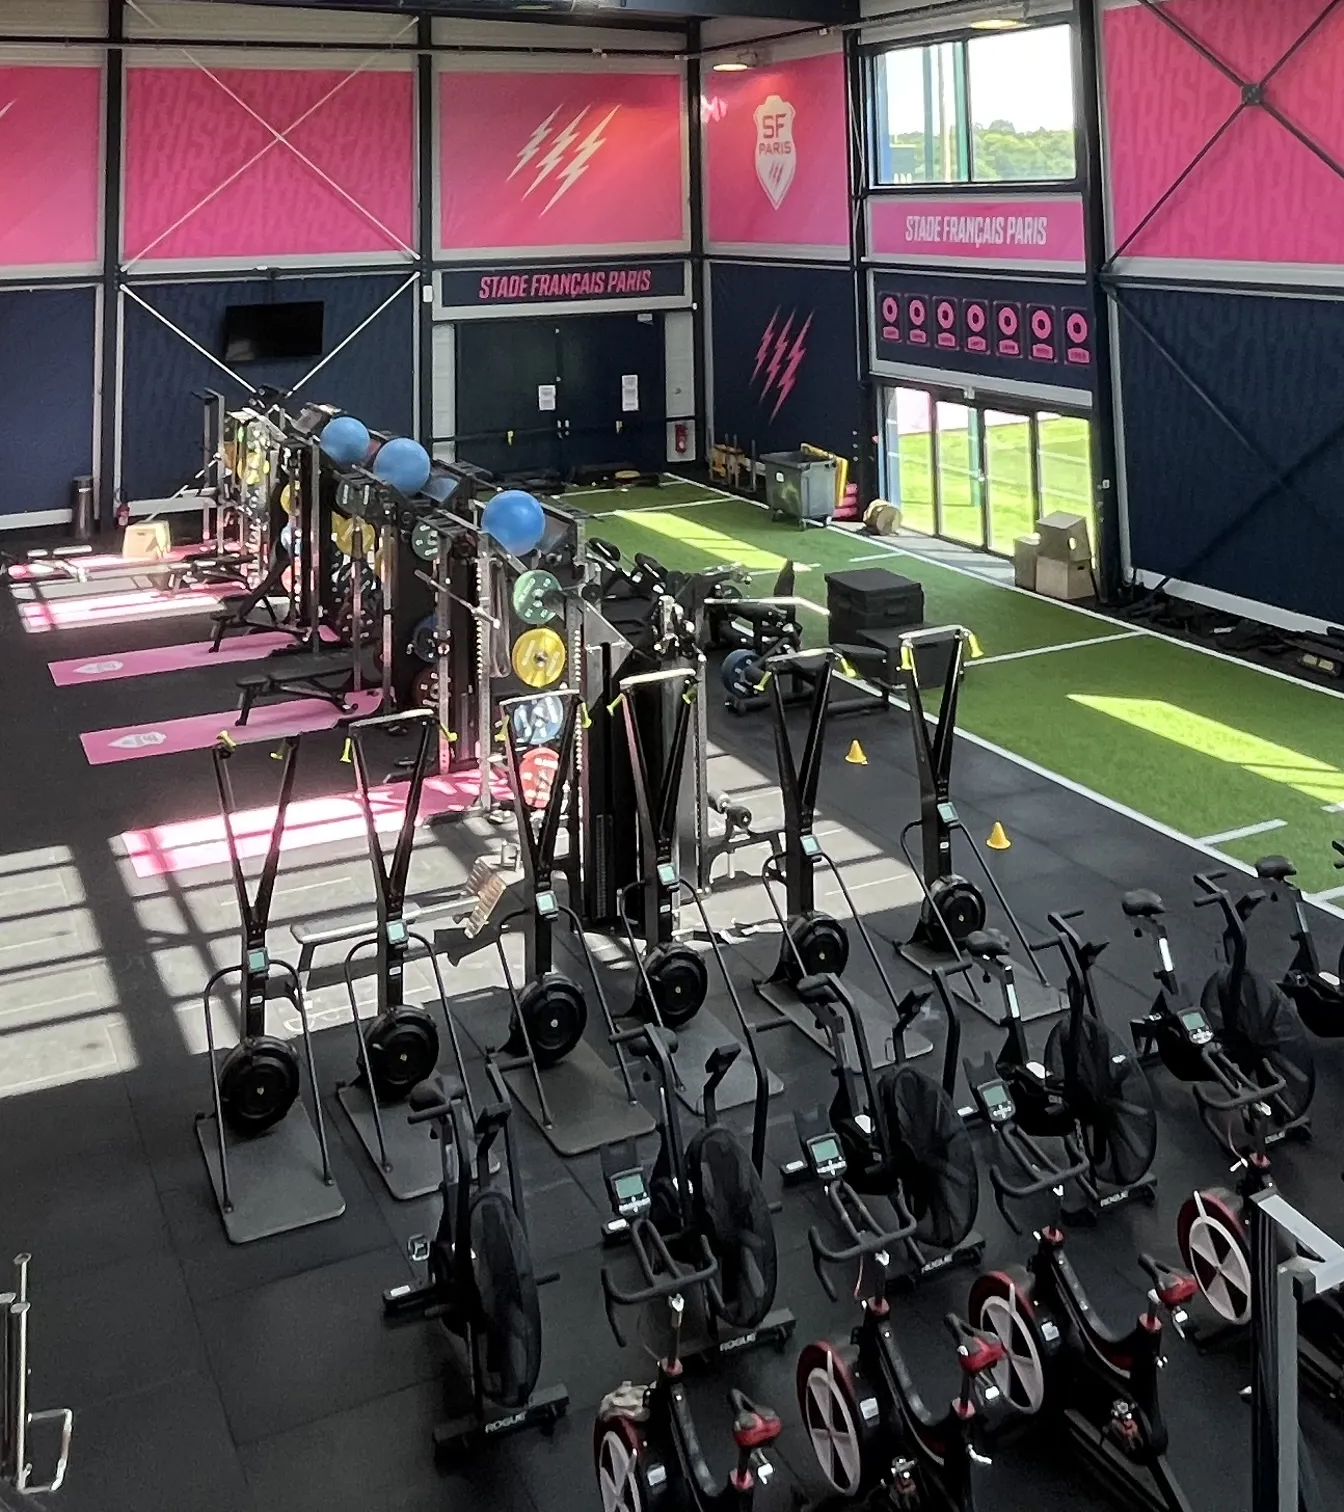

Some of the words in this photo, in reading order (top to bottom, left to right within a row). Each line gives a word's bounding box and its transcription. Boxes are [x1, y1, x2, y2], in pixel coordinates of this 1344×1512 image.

[762, 113, 787, 139] SF
[758, 140, 792, 156] PARIS
[904, 214, 942, 243] STADE
[942, 215, 1005, 247] FRANÇAIS
[1006, 216, 1048, 246] PARIS
[478, 275, 528, 300] STADE
[530, 272, 606, 300] FRANÇAIS
[607, 269, 652, 293] PARIS
